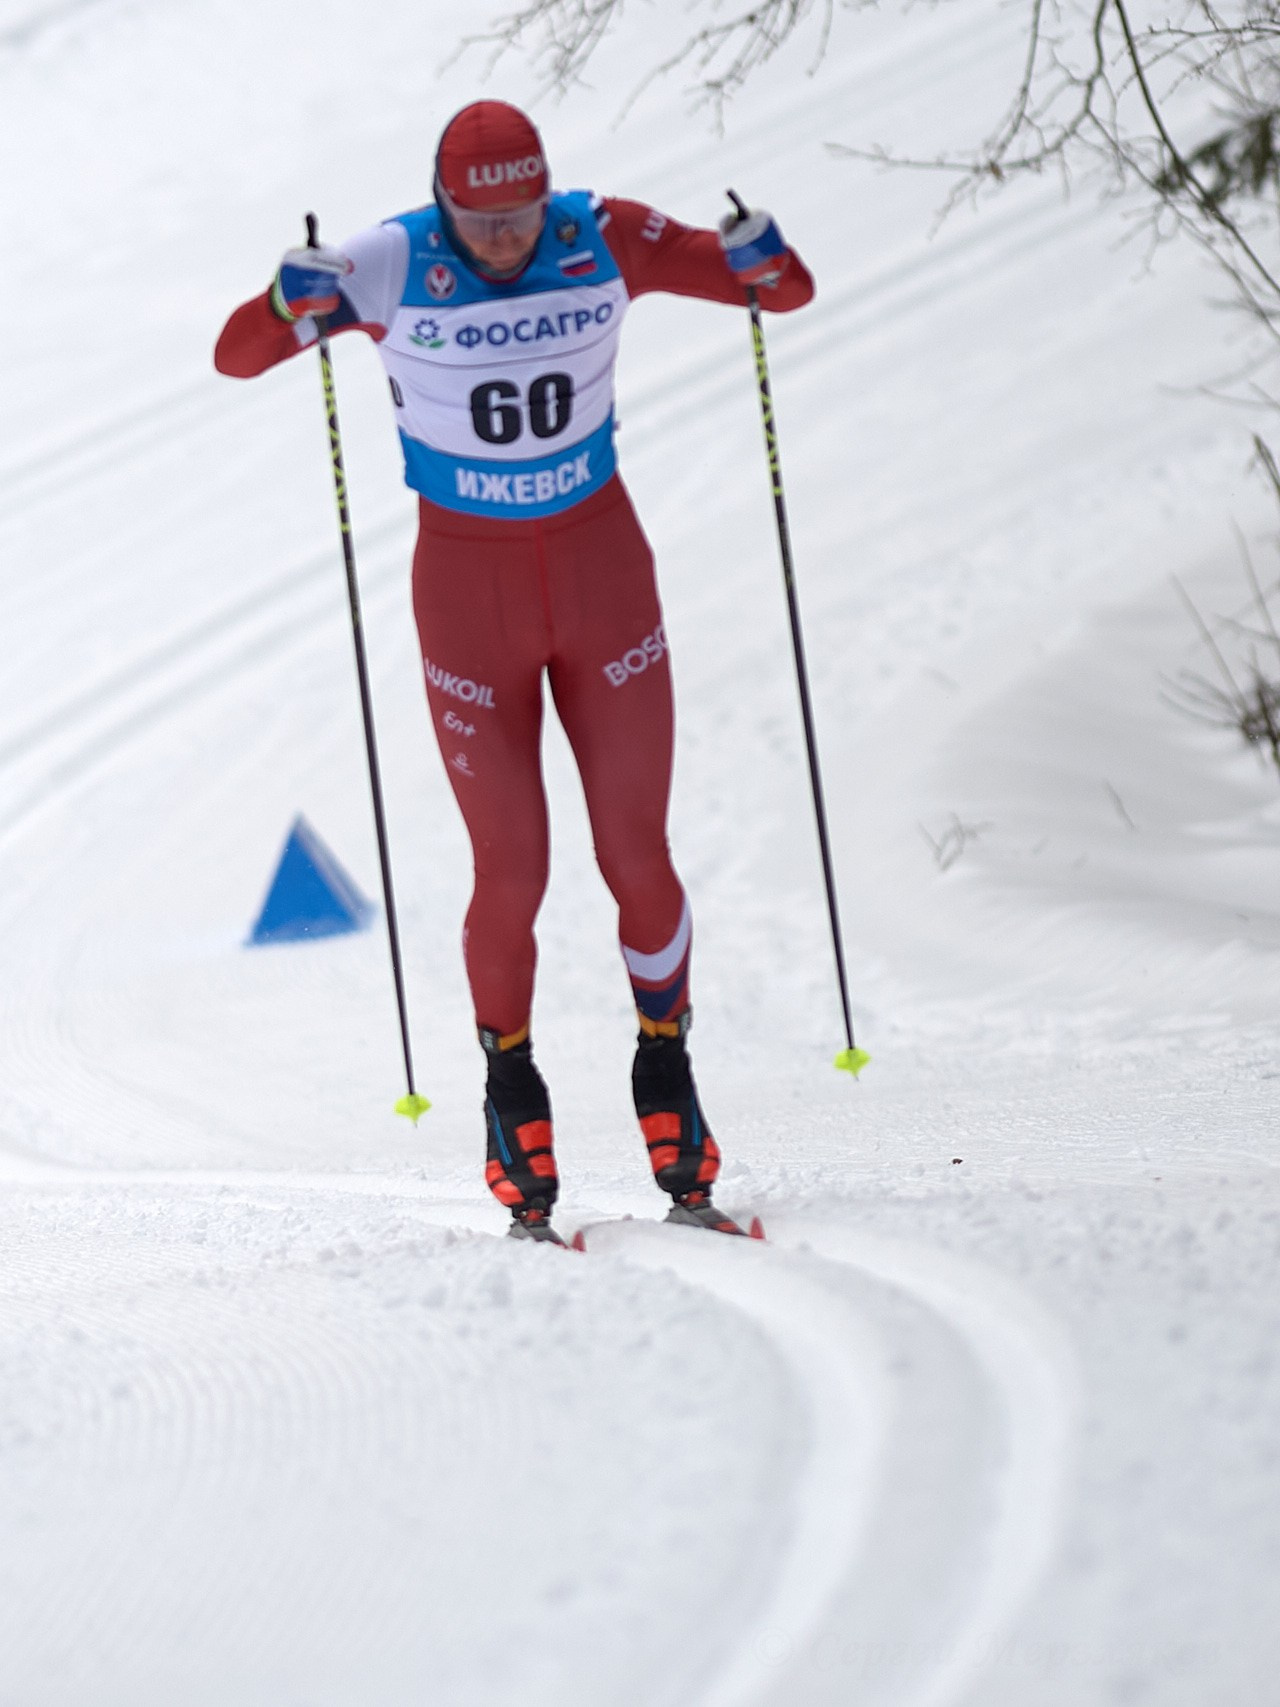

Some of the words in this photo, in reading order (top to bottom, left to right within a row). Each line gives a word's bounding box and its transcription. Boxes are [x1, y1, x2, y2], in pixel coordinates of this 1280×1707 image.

[455, 302, 613, 348] ФОСАГРО
[470, 371, 574, 445] 60
[455, 451, 592, 505] ИЖЕВСК
